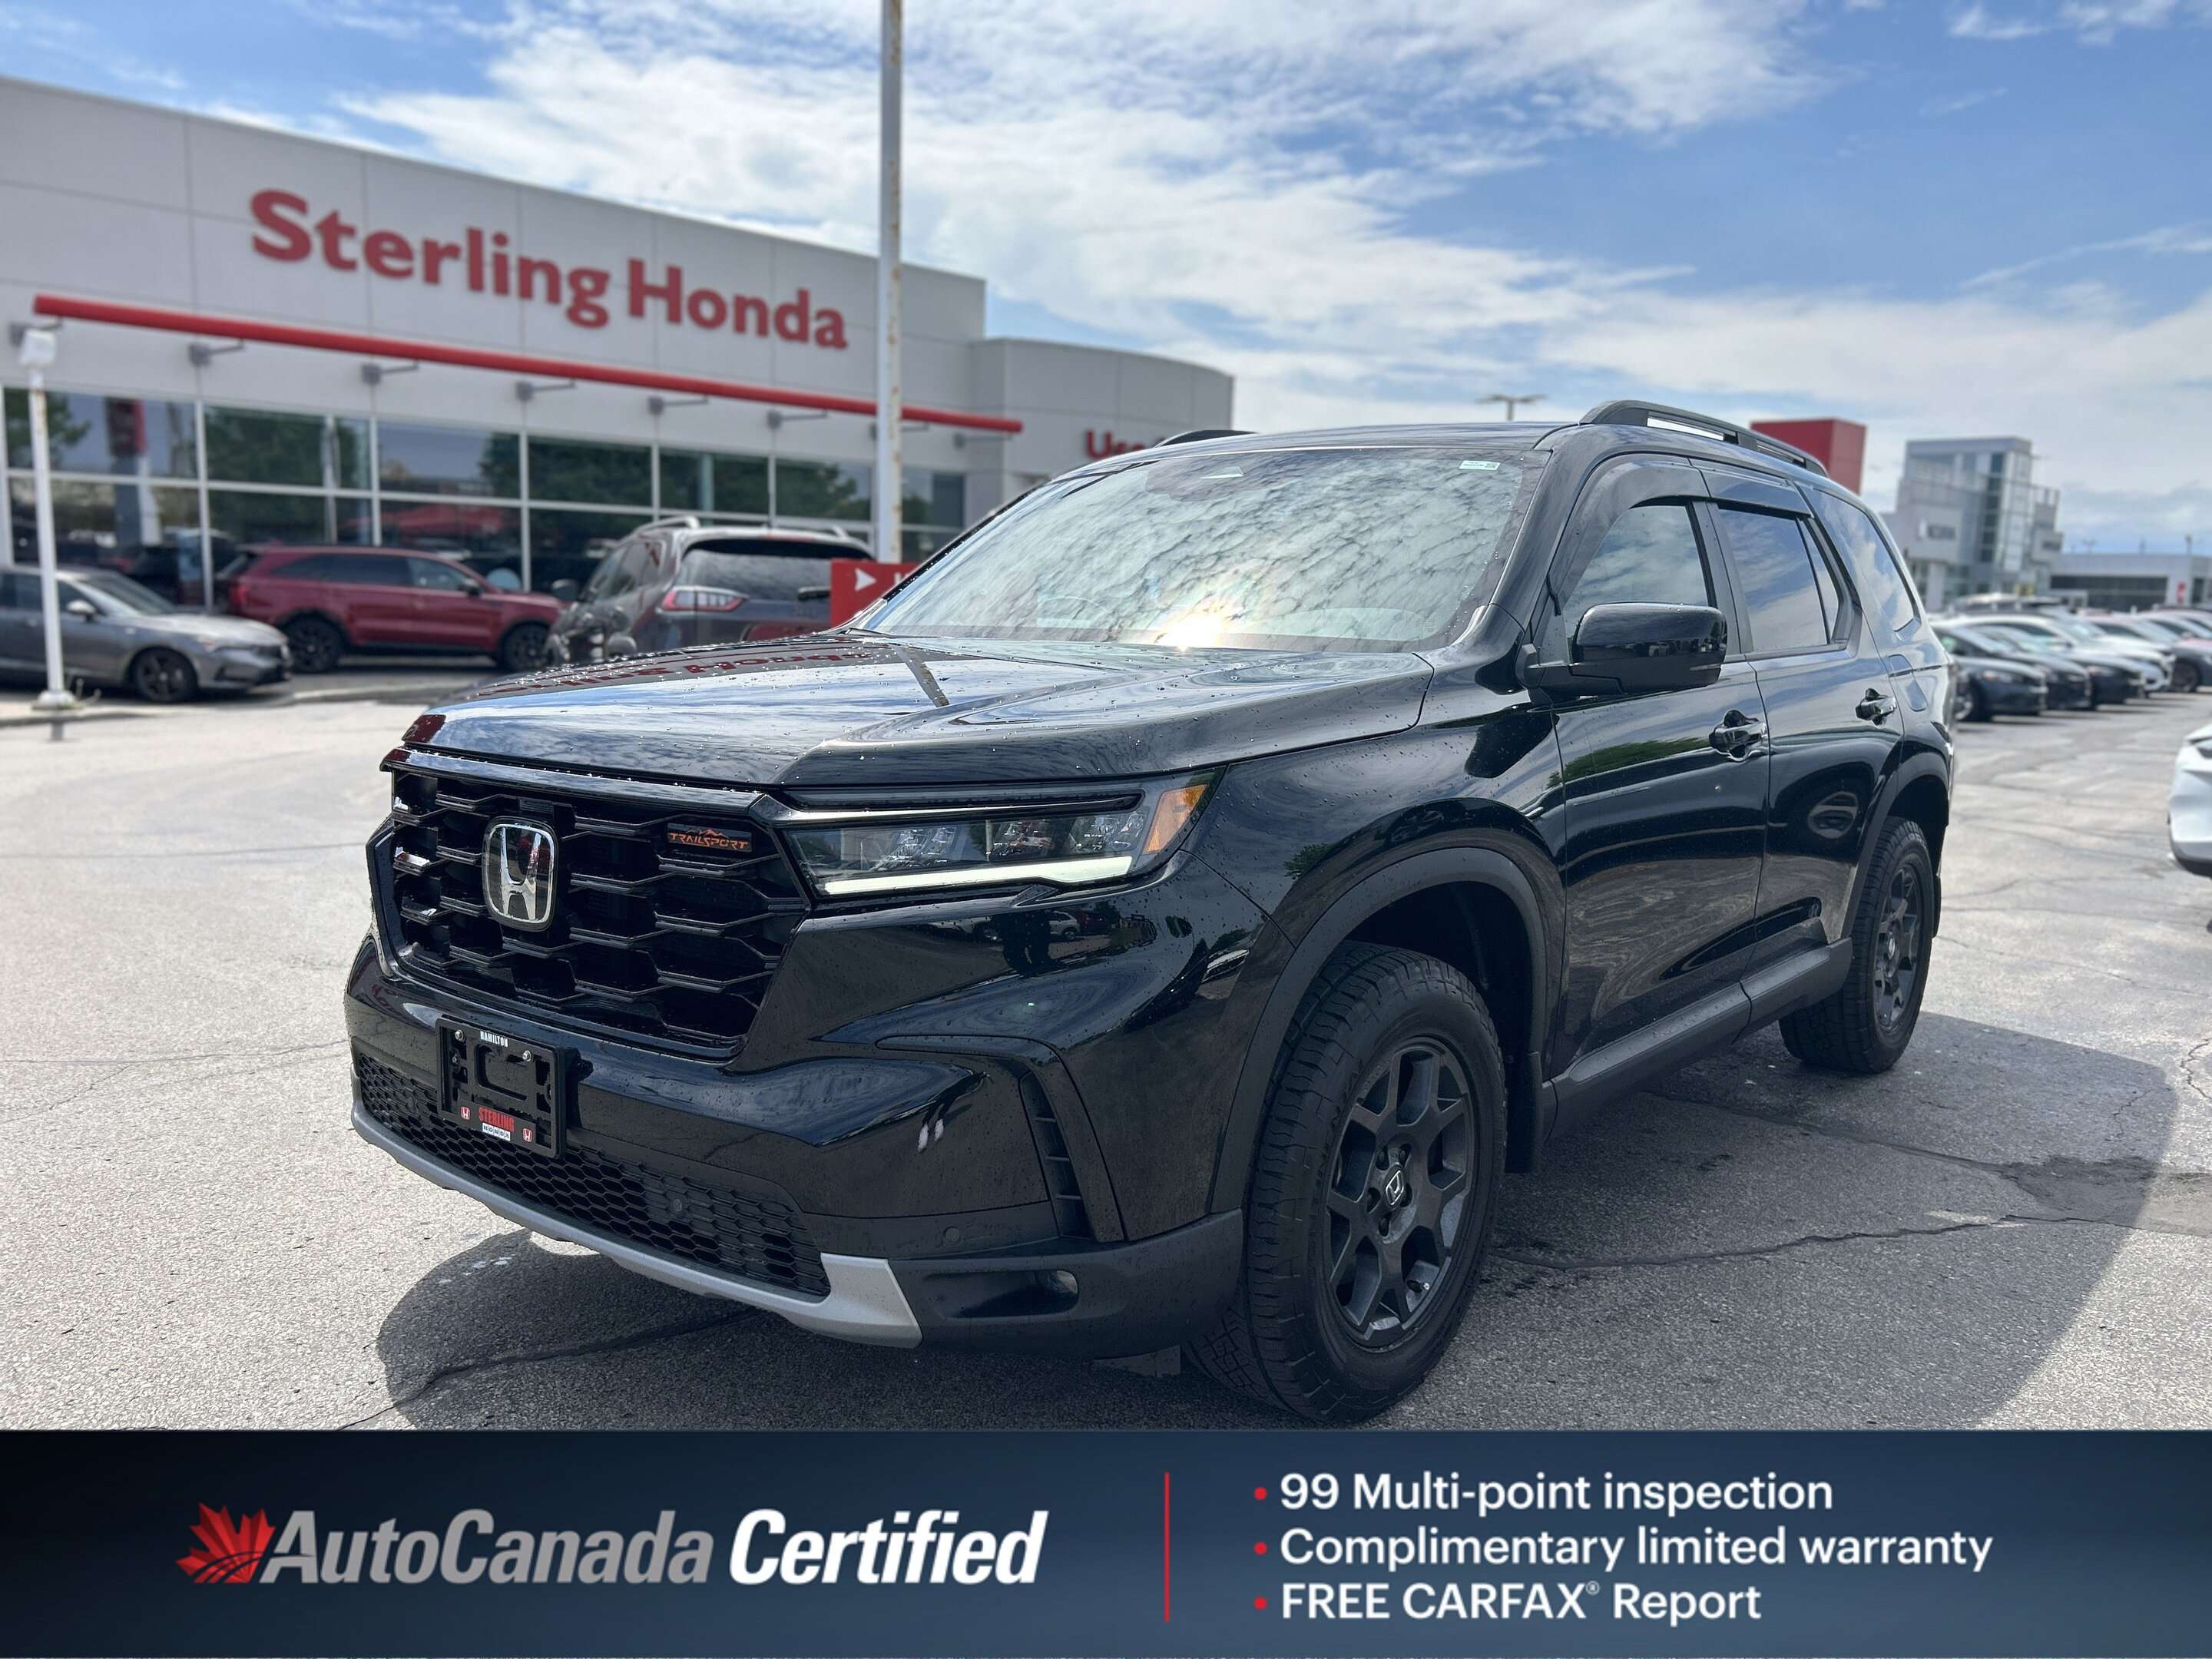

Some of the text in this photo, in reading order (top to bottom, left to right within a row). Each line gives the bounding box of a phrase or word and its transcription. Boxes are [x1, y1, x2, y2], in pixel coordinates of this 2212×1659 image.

[251, 189, 847, 349] Sterling Honda
[669, 832, 749, 850] TRAILSPORT
[480, 1031, 508, 1048] HAMILTON
[478, 1106, 515, 1132] STERLING
[483, 1124, 510, 1140] HONDA
